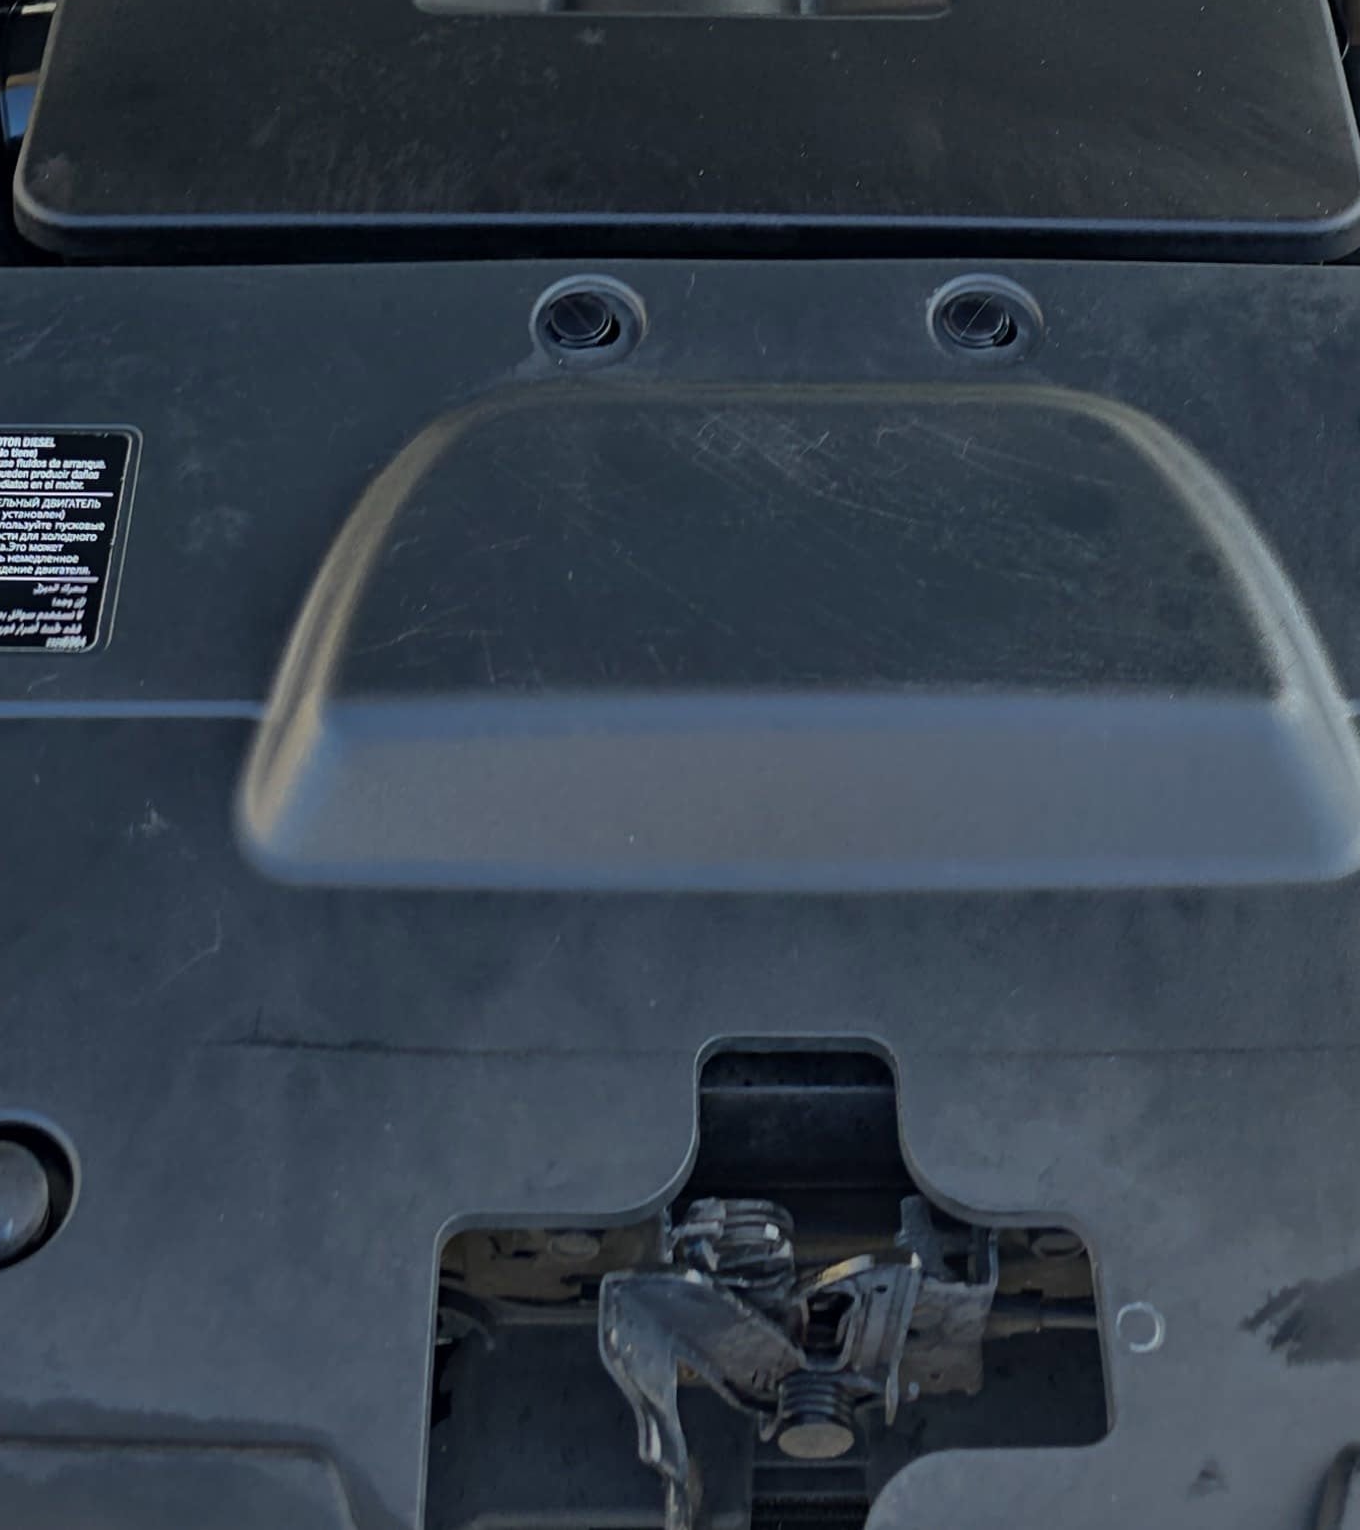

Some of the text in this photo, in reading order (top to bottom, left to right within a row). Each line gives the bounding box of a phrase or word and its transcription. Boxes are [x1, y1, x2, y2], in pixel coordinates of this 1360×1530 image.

[23, 436, 56, 447] DIESEL
[30, 469, 70, 480] producir
[30, 480, 42, 489] en
[41, 497, 102, 509] ДВИГАТЕЛЬ
[1, 509, 66, 520] установлен)
[55, 521, 105, 532] пусковые
[19, 532, 39, 542] для
[40, 532, 98, 542] холодного
[28, 543, 64, 553] может
[7, 554, 79, 564] немедленное
[34, 565, 91, 576] двигателя.
